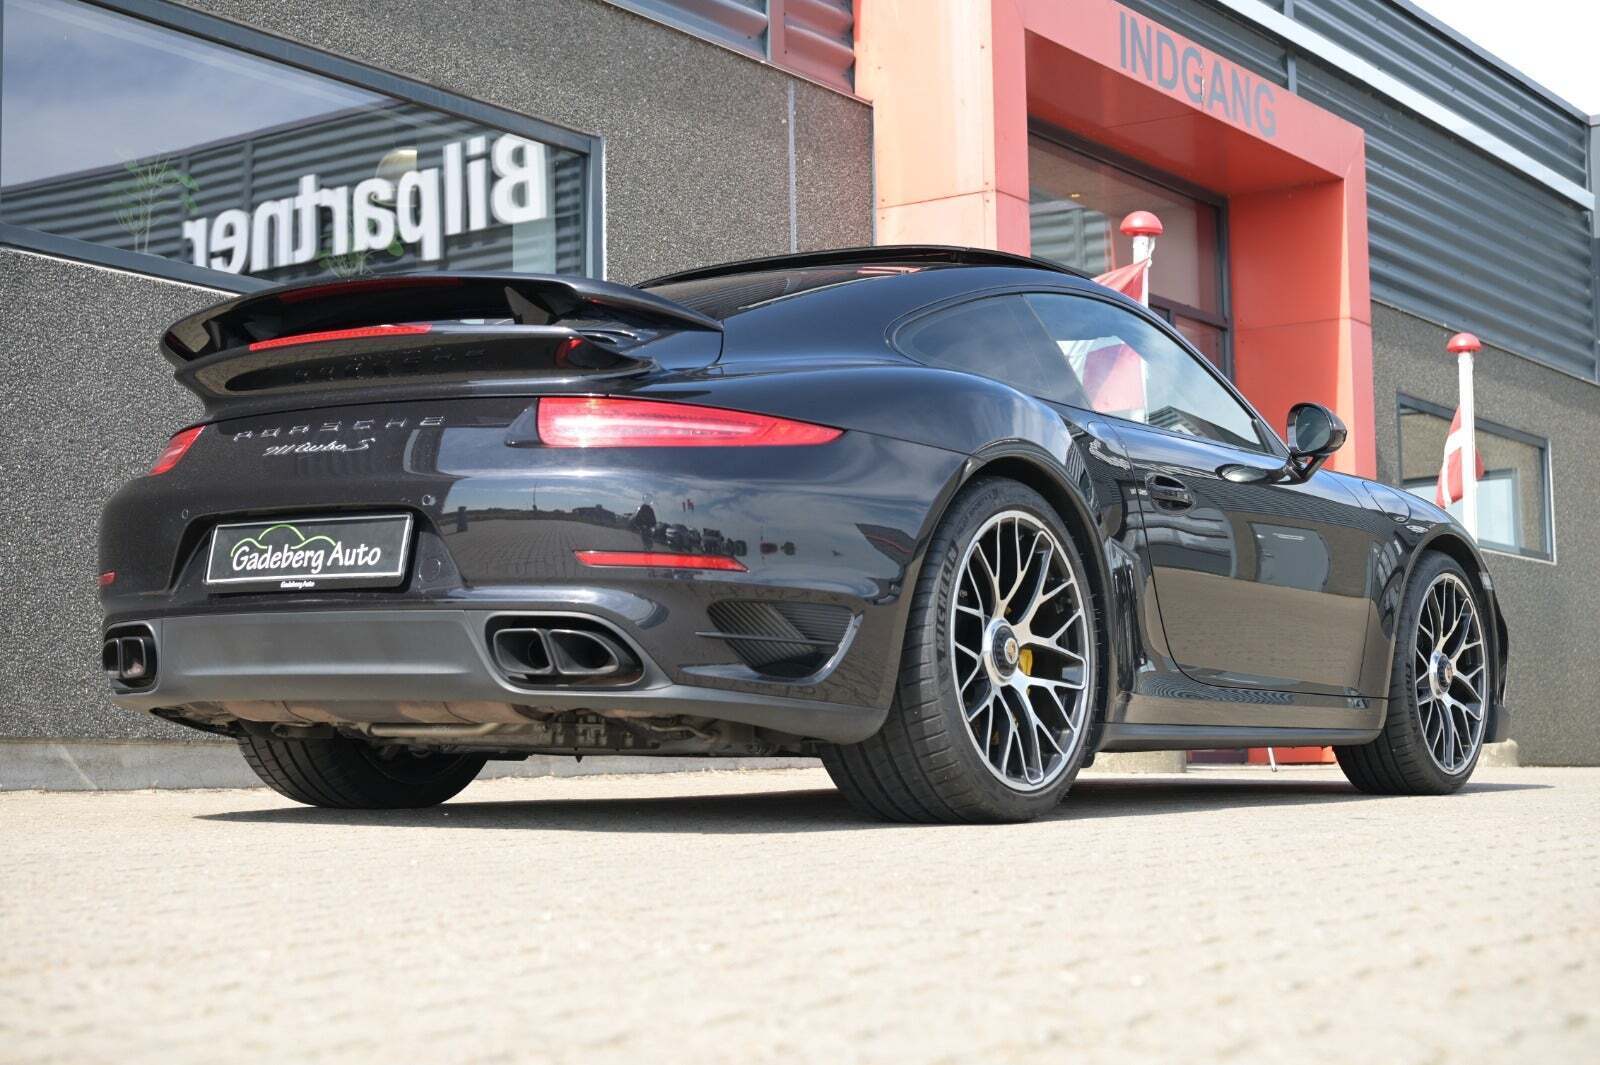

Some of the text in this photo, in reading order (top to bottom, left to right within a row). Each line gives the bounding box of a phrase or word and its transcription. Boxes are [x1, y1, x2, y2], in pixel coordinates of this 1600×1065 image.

[1119, 12, 1277, 137] INDGANG
[234, 416, 445, 441] PORSCHE
[262, 437, 377, 457] 911 turbo S
[232, 541, 381, 574] Gadeberg Auto
[936, 545, 958, 652] MICHELIN
